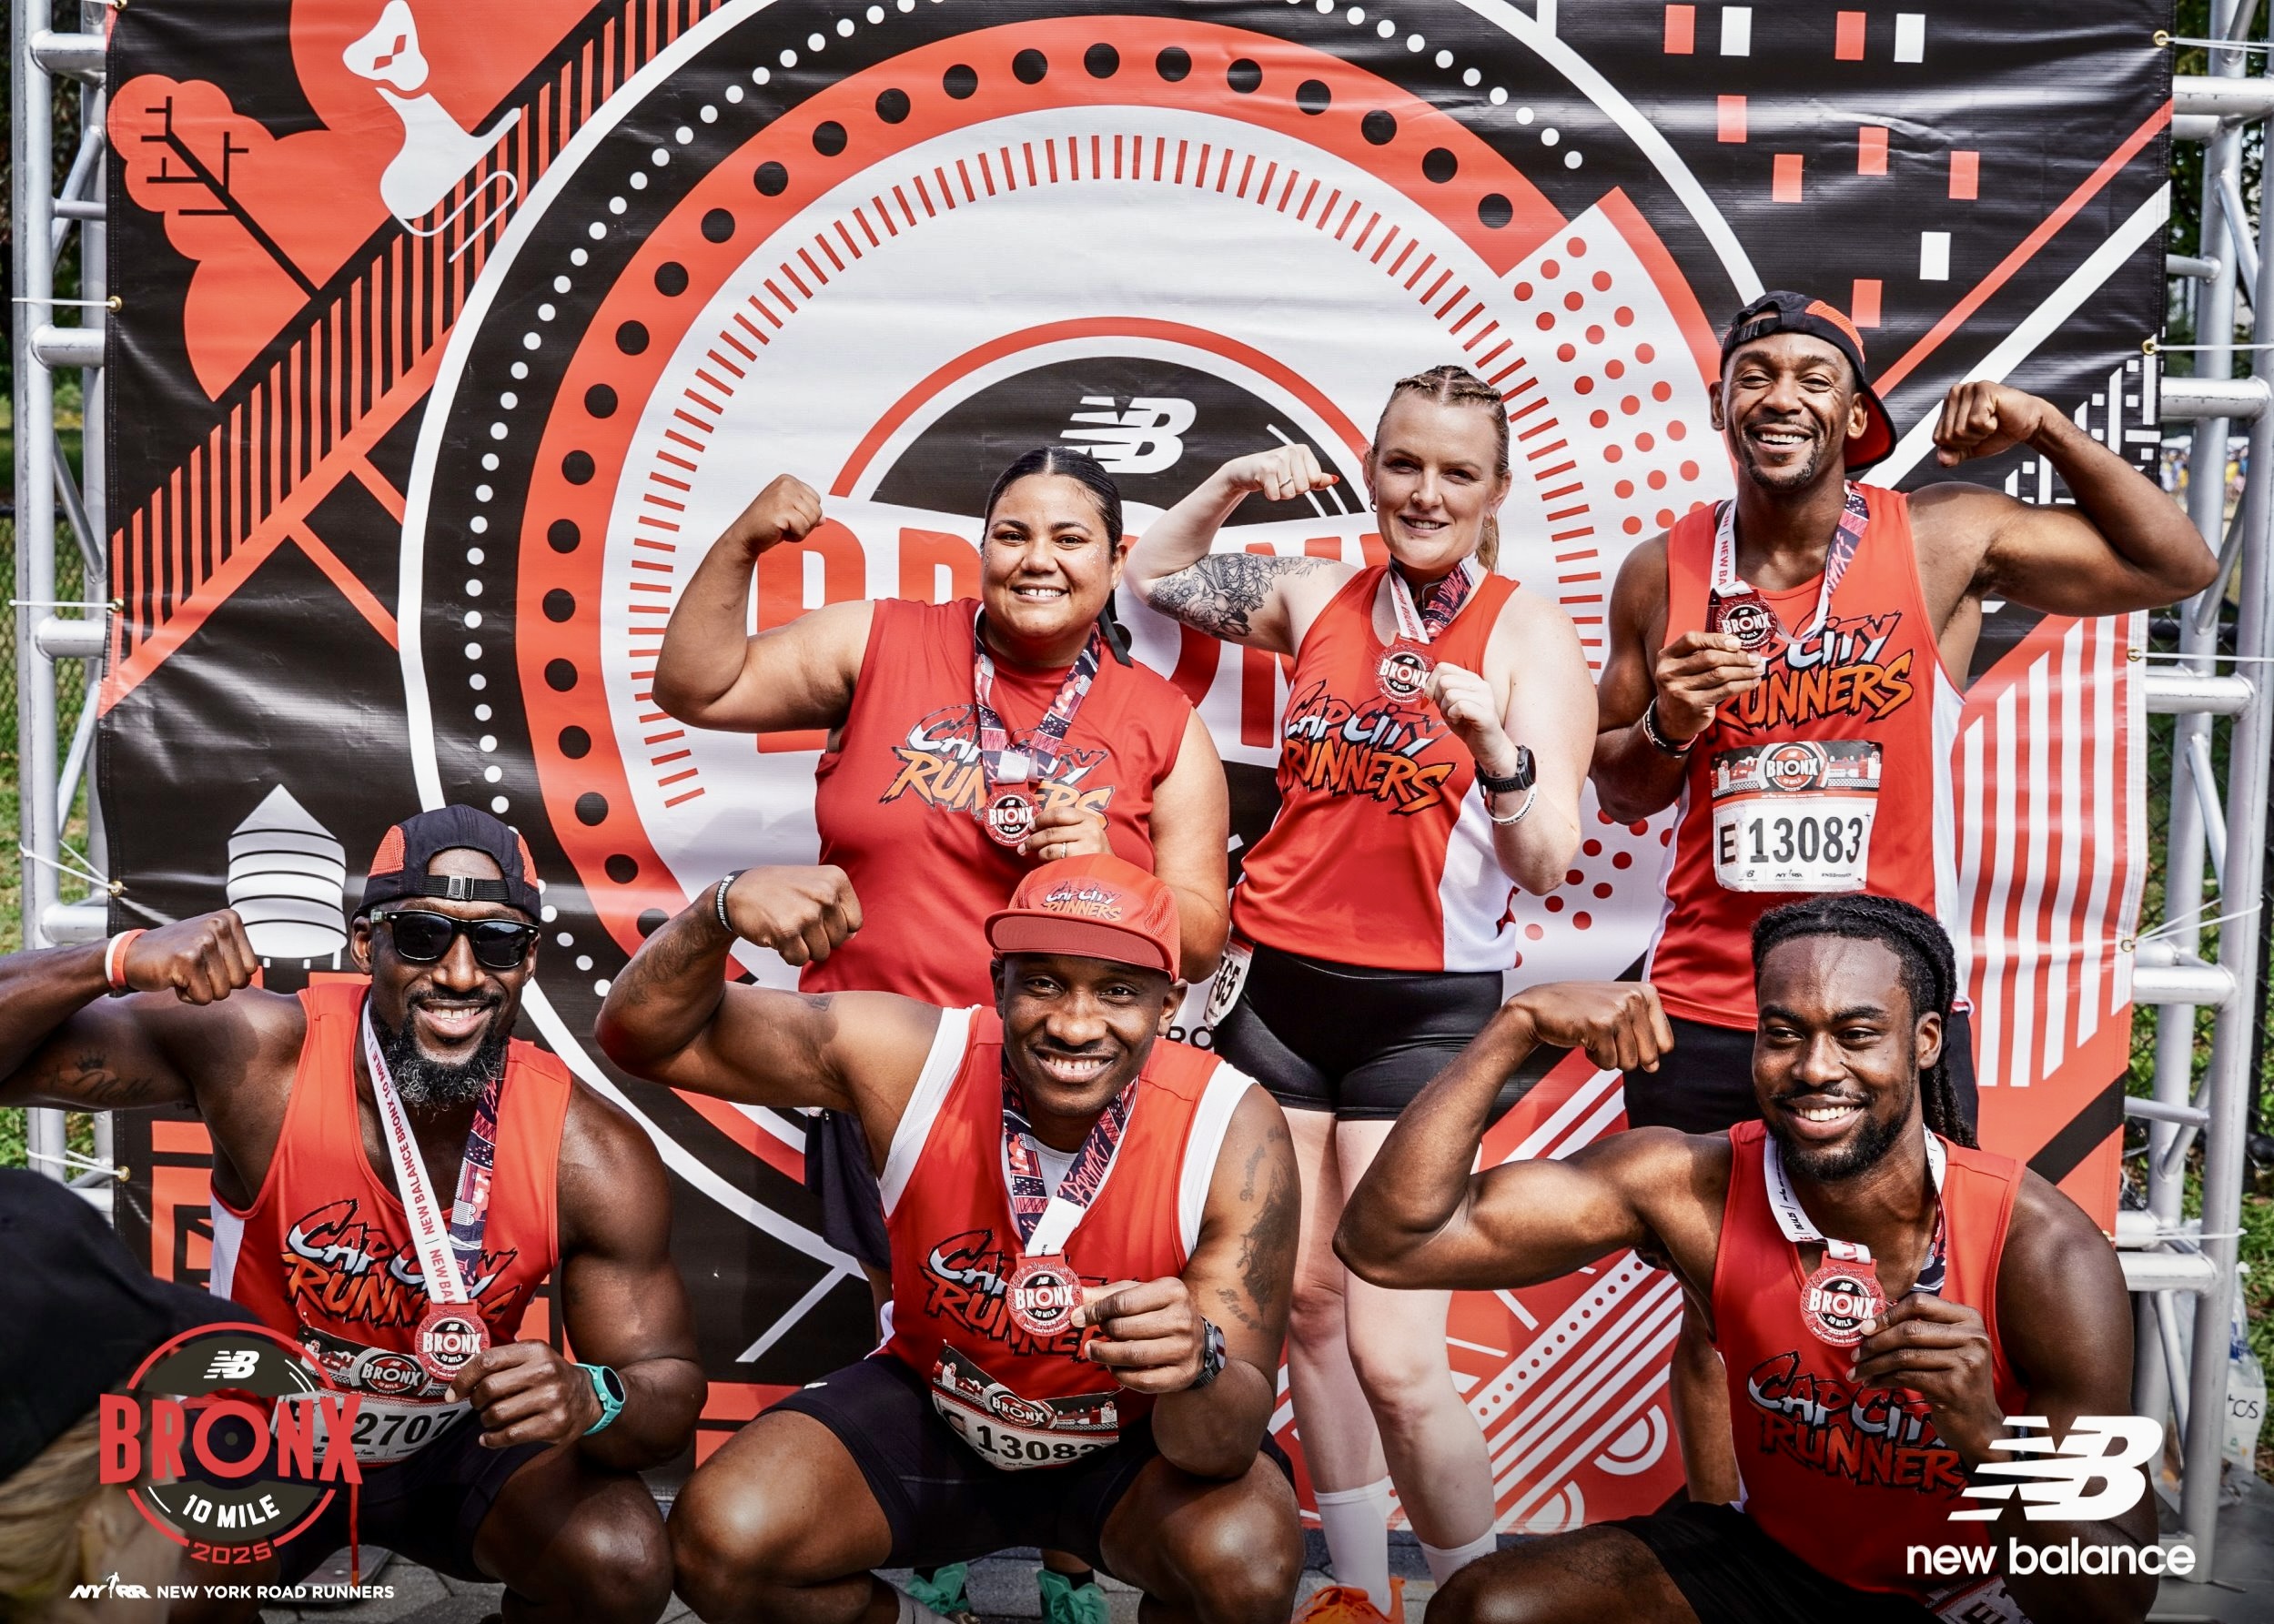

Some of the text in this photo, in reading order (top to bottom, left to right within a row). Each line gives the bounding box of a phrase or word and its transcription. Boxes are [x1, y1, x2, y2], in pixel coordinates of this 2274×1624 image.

[1719, 540, 1729, 567] NEW
[1722, 612, 1772, 635] BRONX
[1379, 659, 1430, 688] BRONX
[1284, 679, 1352, 741] CAP
[906, 704, 983, 763] CA
[1277, 738, 1457, 816] RUNNERS
[1766, 758, 1818, 778] BRONX
[879, 746, 1116, 831] RUNERS
[988, 806, 1034, 825] BRONX
[1720, 816, 1864, 864] E 13083
[1041, 900, 1123, 923] RUNNERS
[372, 1050, 435, 1236] NEW BALANCE BRONX 10 MILE
[286, 1198, 518, 1300] CAP CY
[430, 1248, 449, 1278] NEW
[281, 1252, 522, 1326] RUNNS
[1015, 1285, 1075, 1310] BRONX
[1808, 1287, 1877, 1320] BRONX
[1042, 1308, 1057, 1318] MILE
[1827, 1316, 1853, 1327] 10 MILE
[423, 1331, 481, 1354] BRONX
[361, 1362, 422, 1387] BRONX
[1747, 1351, 1851, 1426] CAP
[992, 1397, 1045, 1423] BRONX
[321, 1407, 460, 1447] 2707
[1751, 1404, 1969, 1499] RUNNER
